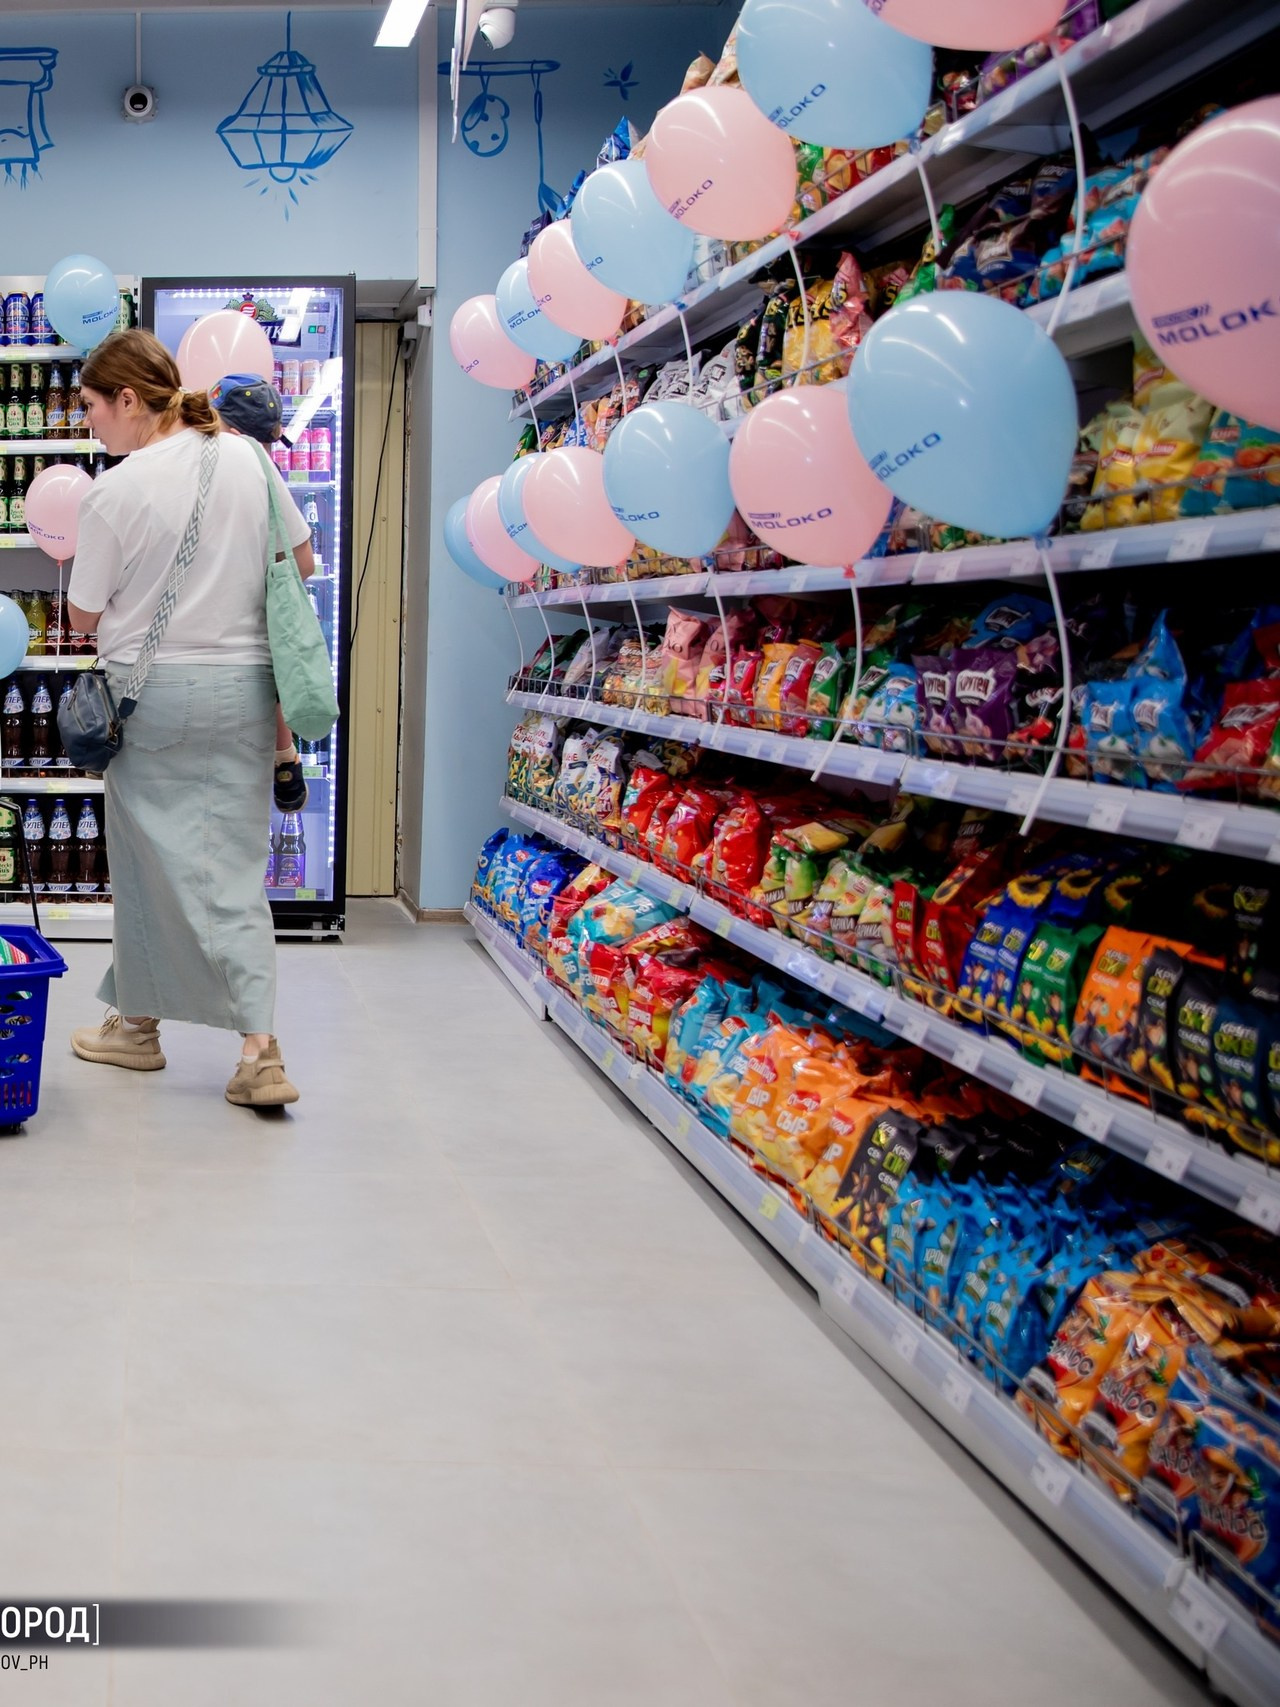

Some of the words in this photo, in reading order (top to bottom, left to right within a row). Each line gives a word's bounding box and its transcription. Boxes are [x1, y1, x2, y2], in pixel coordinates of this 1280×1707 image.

[509, 307, 542, 330] MOLOK
[1158, 299, 1278, 347] MOLOK
[614, 510, 660, 522] OLOKO
[751, 508, 832, 530] MOLOKO
[776, 1110, 809, 1136] СЫР
